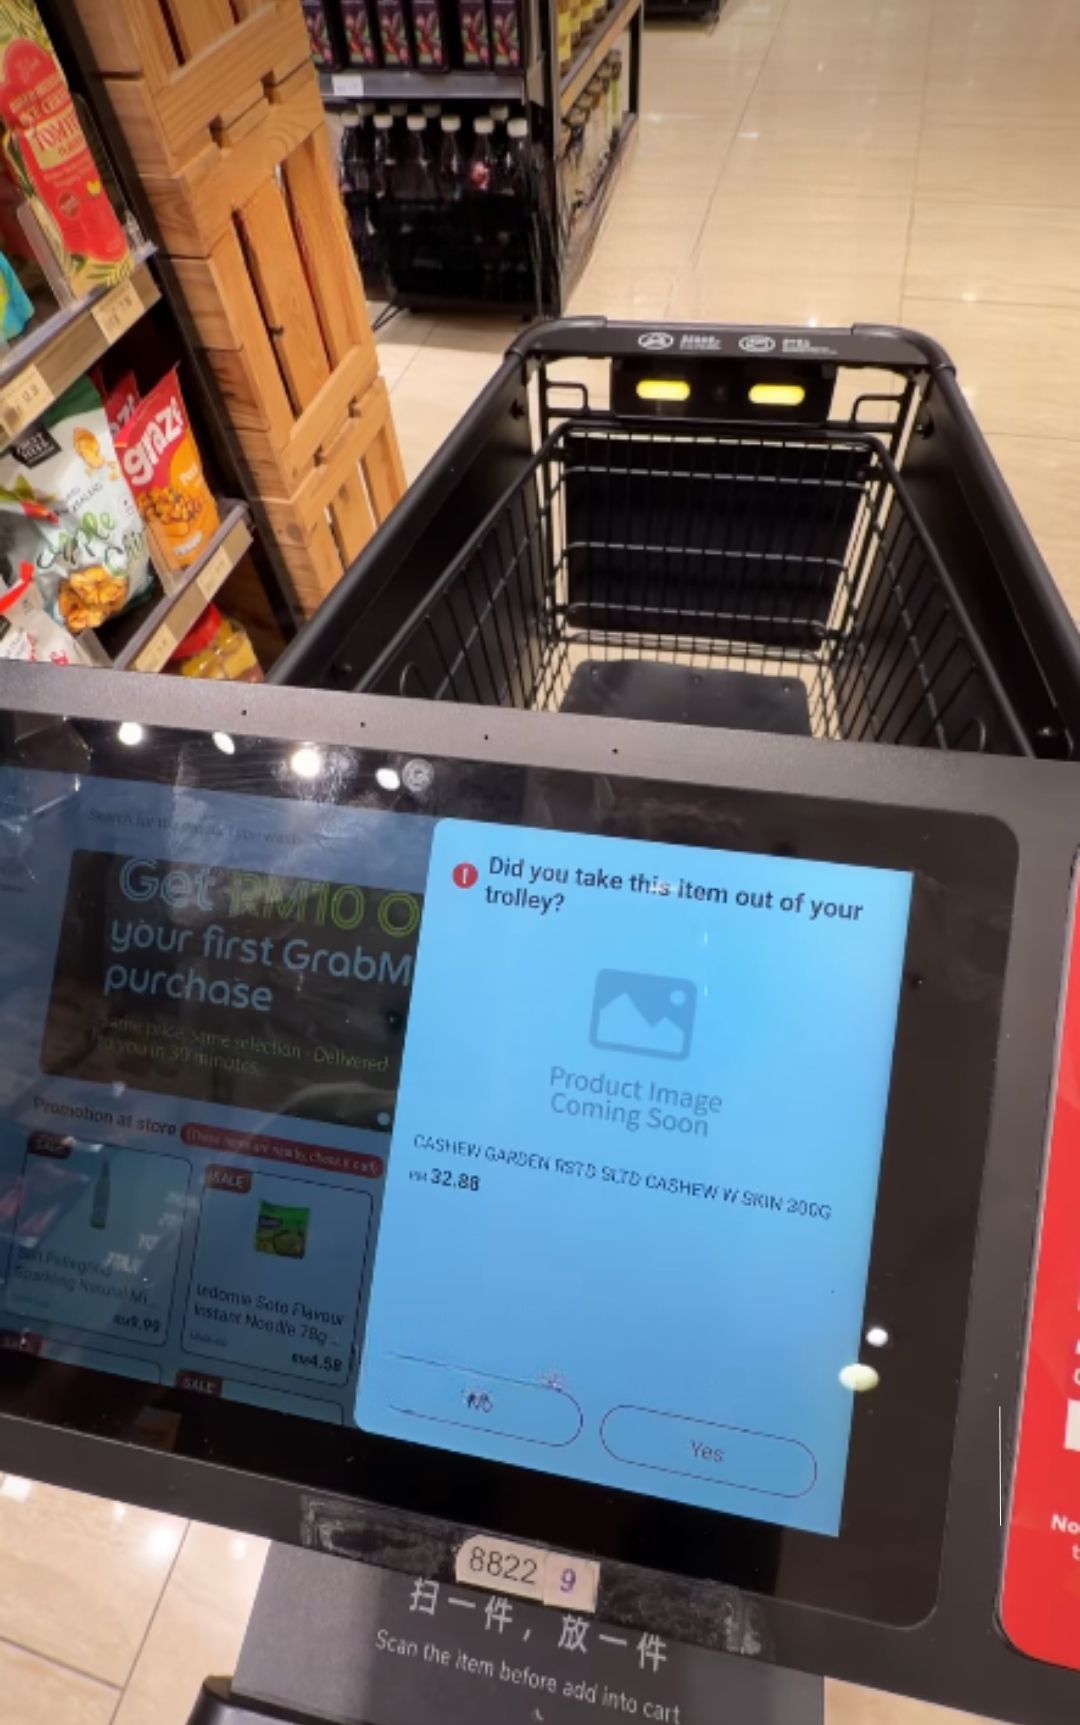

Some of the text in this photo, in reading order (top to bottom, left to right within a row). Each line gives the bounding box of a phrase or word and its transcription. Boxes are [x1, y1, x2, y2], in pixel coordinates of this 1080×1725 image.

[118, 859, 217, 913] Get
[226, 871, 365, 931] RM10
[484, 886, 565, 914] trolley?
[489, 856, 863, 921] Did you take this item out of your
[110, 918, 413, 987] your first GrabM
[103, 964, 273, 1013] purchase
[312, 1045, 391, 1073] Delivered
[550, 1065, 723, 1117] Product Image
[550, 1091, 709, 1137] Coming Soon
[33, 1096, 177, 1136] Promotion at store
[413, 1133, 481, 1158] CASHEW
[484, 1146, 551, 1172] GARDEN
[555, 1158, 597, 1179] RSTD
[601, 1165, 642, 1187] SLTD
[645, 1174, 719, 1200] CASHEW
[723, 1187, 739, 1204] W
[743, 1189, 784, 1211] SKIN
[690, 1439, 726, 1465] Yes
[469, 1545, 577, 1593] 8822 9
[375, 1628, 682, 1725] Scan the item before add into cart
